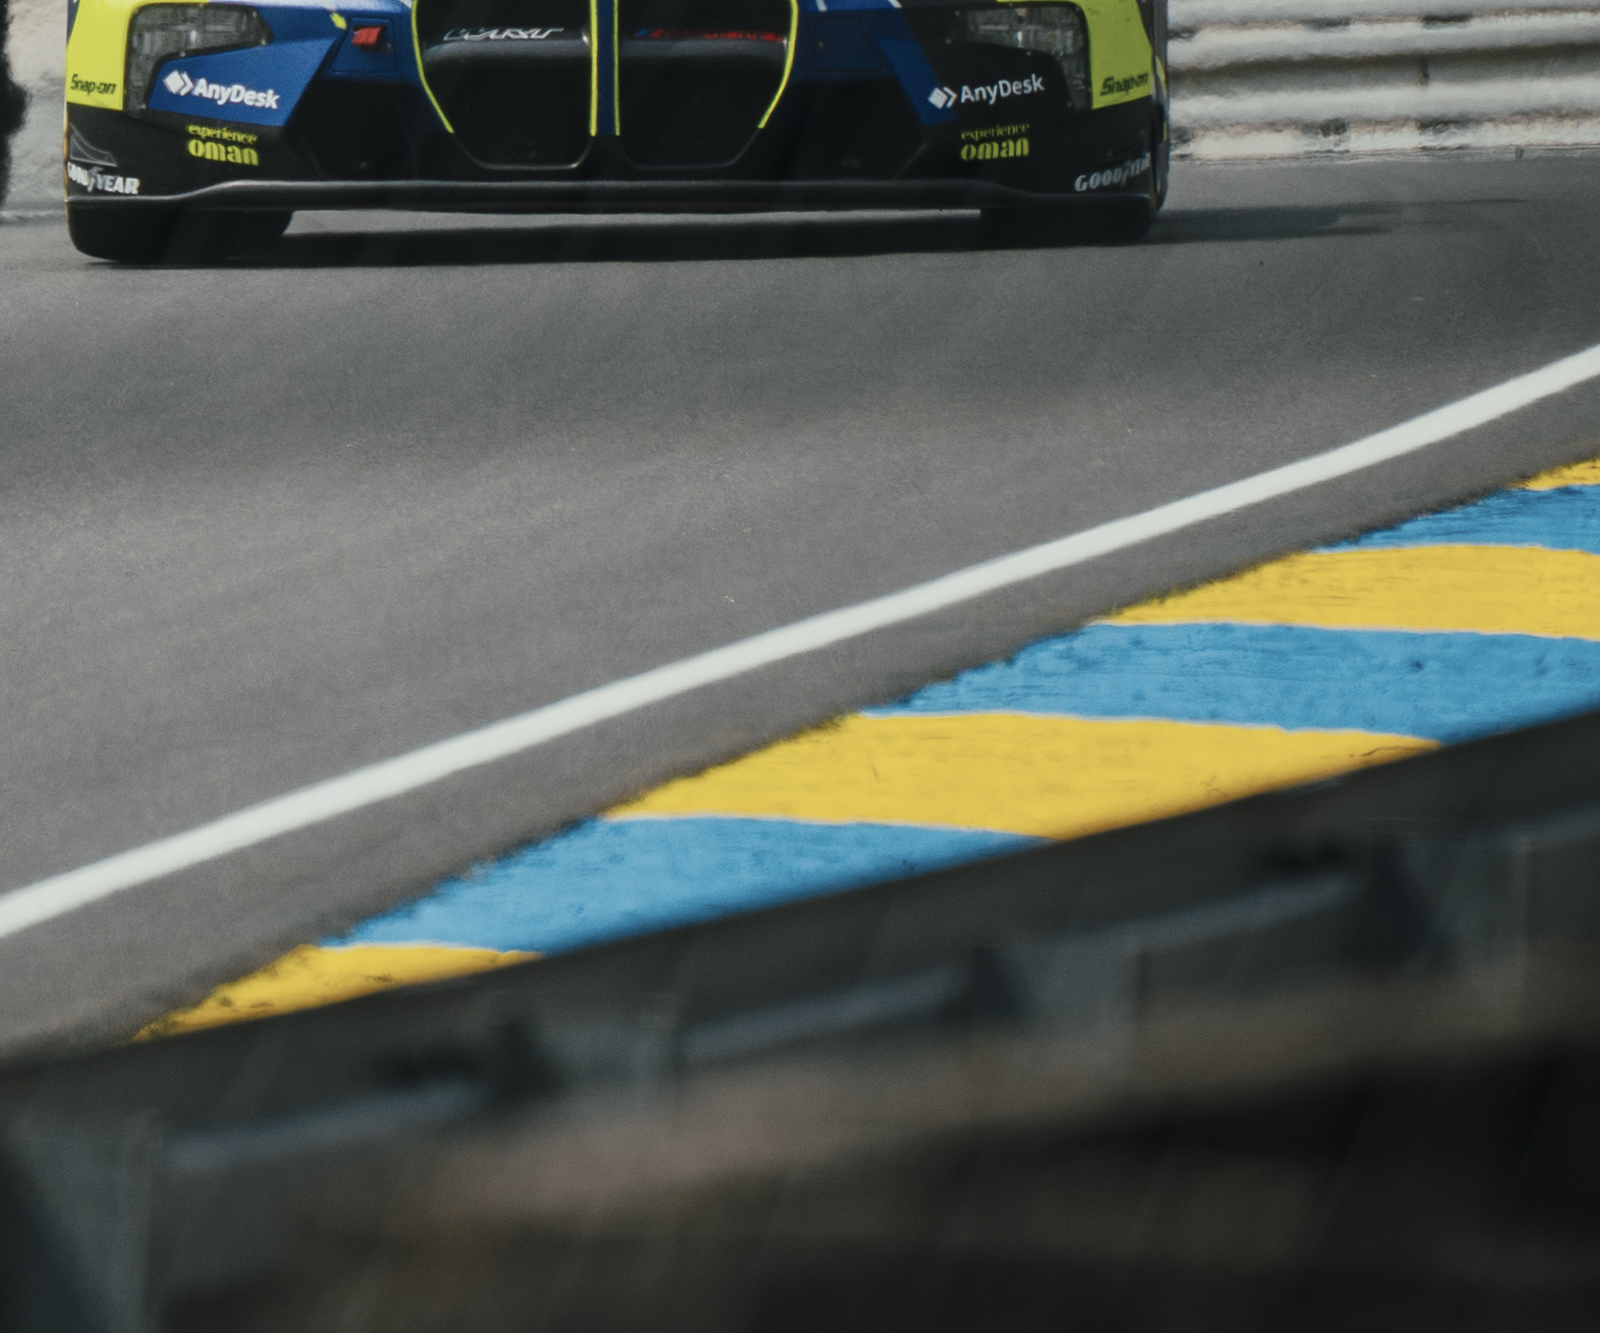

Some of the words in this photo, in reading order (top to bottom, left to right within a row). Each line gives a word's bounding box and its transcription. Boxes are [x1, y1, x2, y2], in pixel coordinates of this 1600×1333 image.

[70, 73, 117, 96] Snap-on
[194, 78, 281, 109] AnyDesk
[960, 73, 1045, 105] AnyDesk
[187, 124, 258, 145] experience
[961, 122, 1030, 141] experience
[187, 139, 259, 166] oman
[960, 137, 1030, 161] oman
